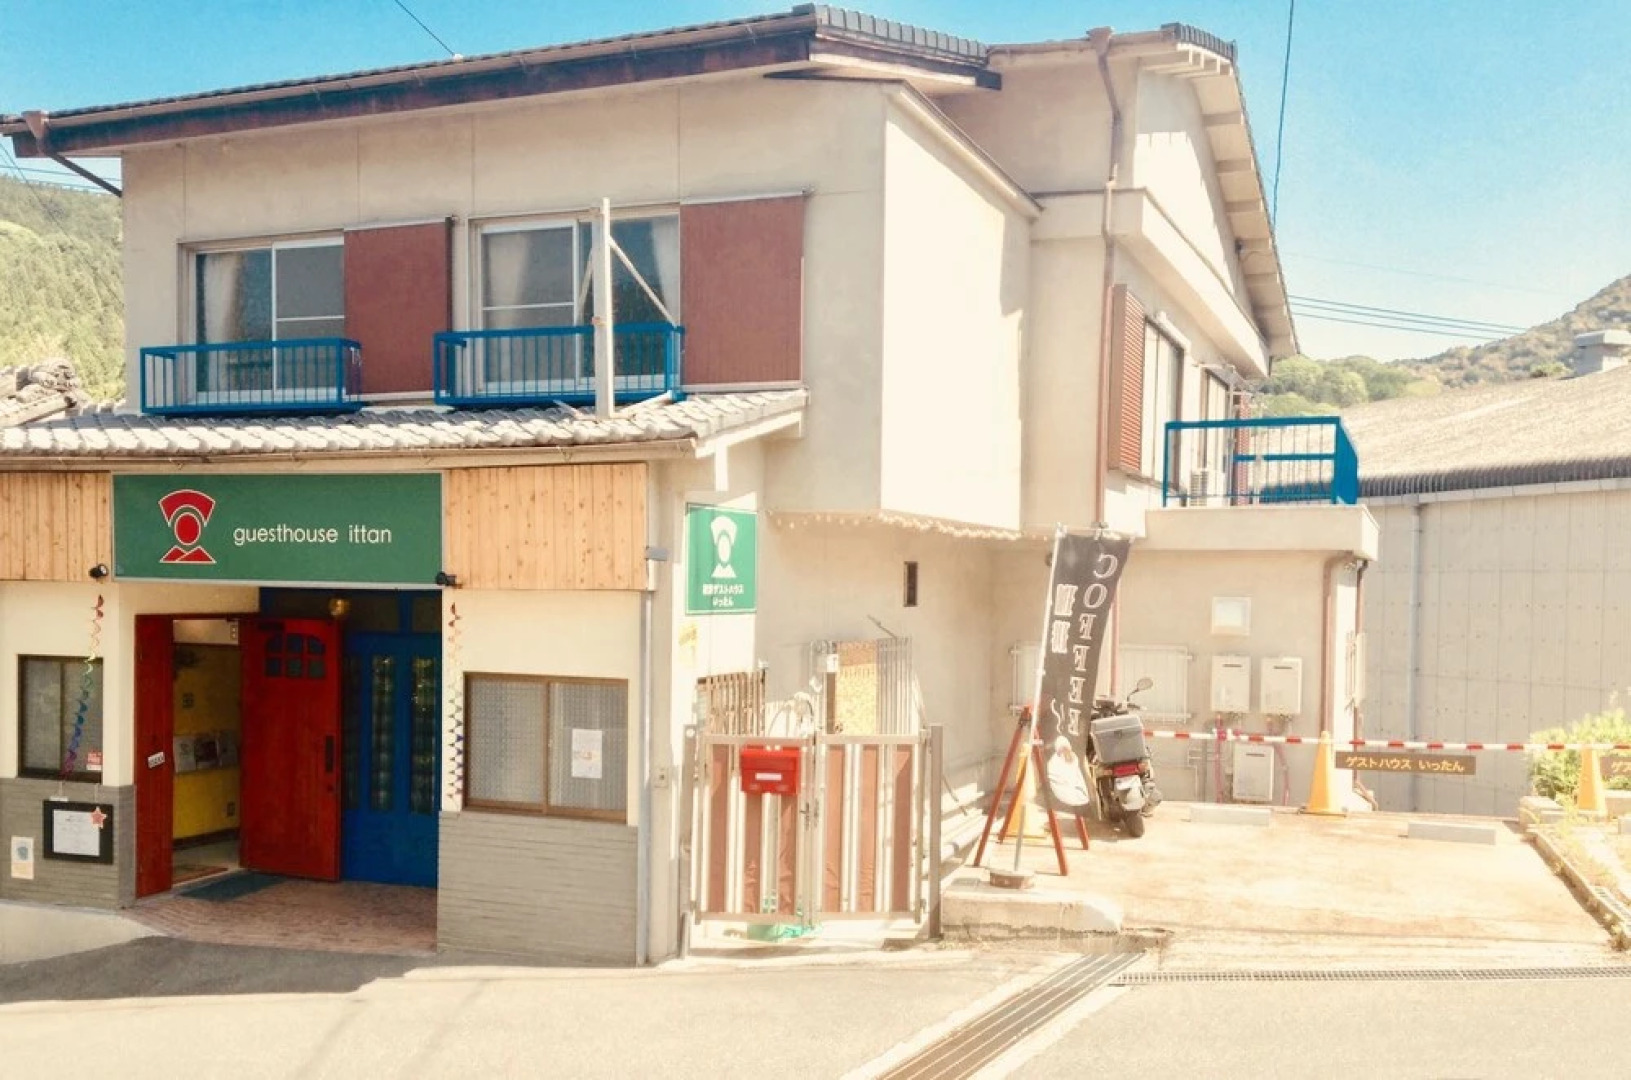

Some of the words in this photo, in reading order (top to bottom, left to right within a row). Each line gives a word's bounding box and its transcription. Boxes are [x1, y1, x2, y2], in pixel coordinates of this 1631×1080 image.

[233, 523, 339, 546] guesthouse
[348, 524, 392, 544] ittan
[1346, 756, 1412, 770] ゲストハウス
[1418, 760, 1465, 773] いったん
